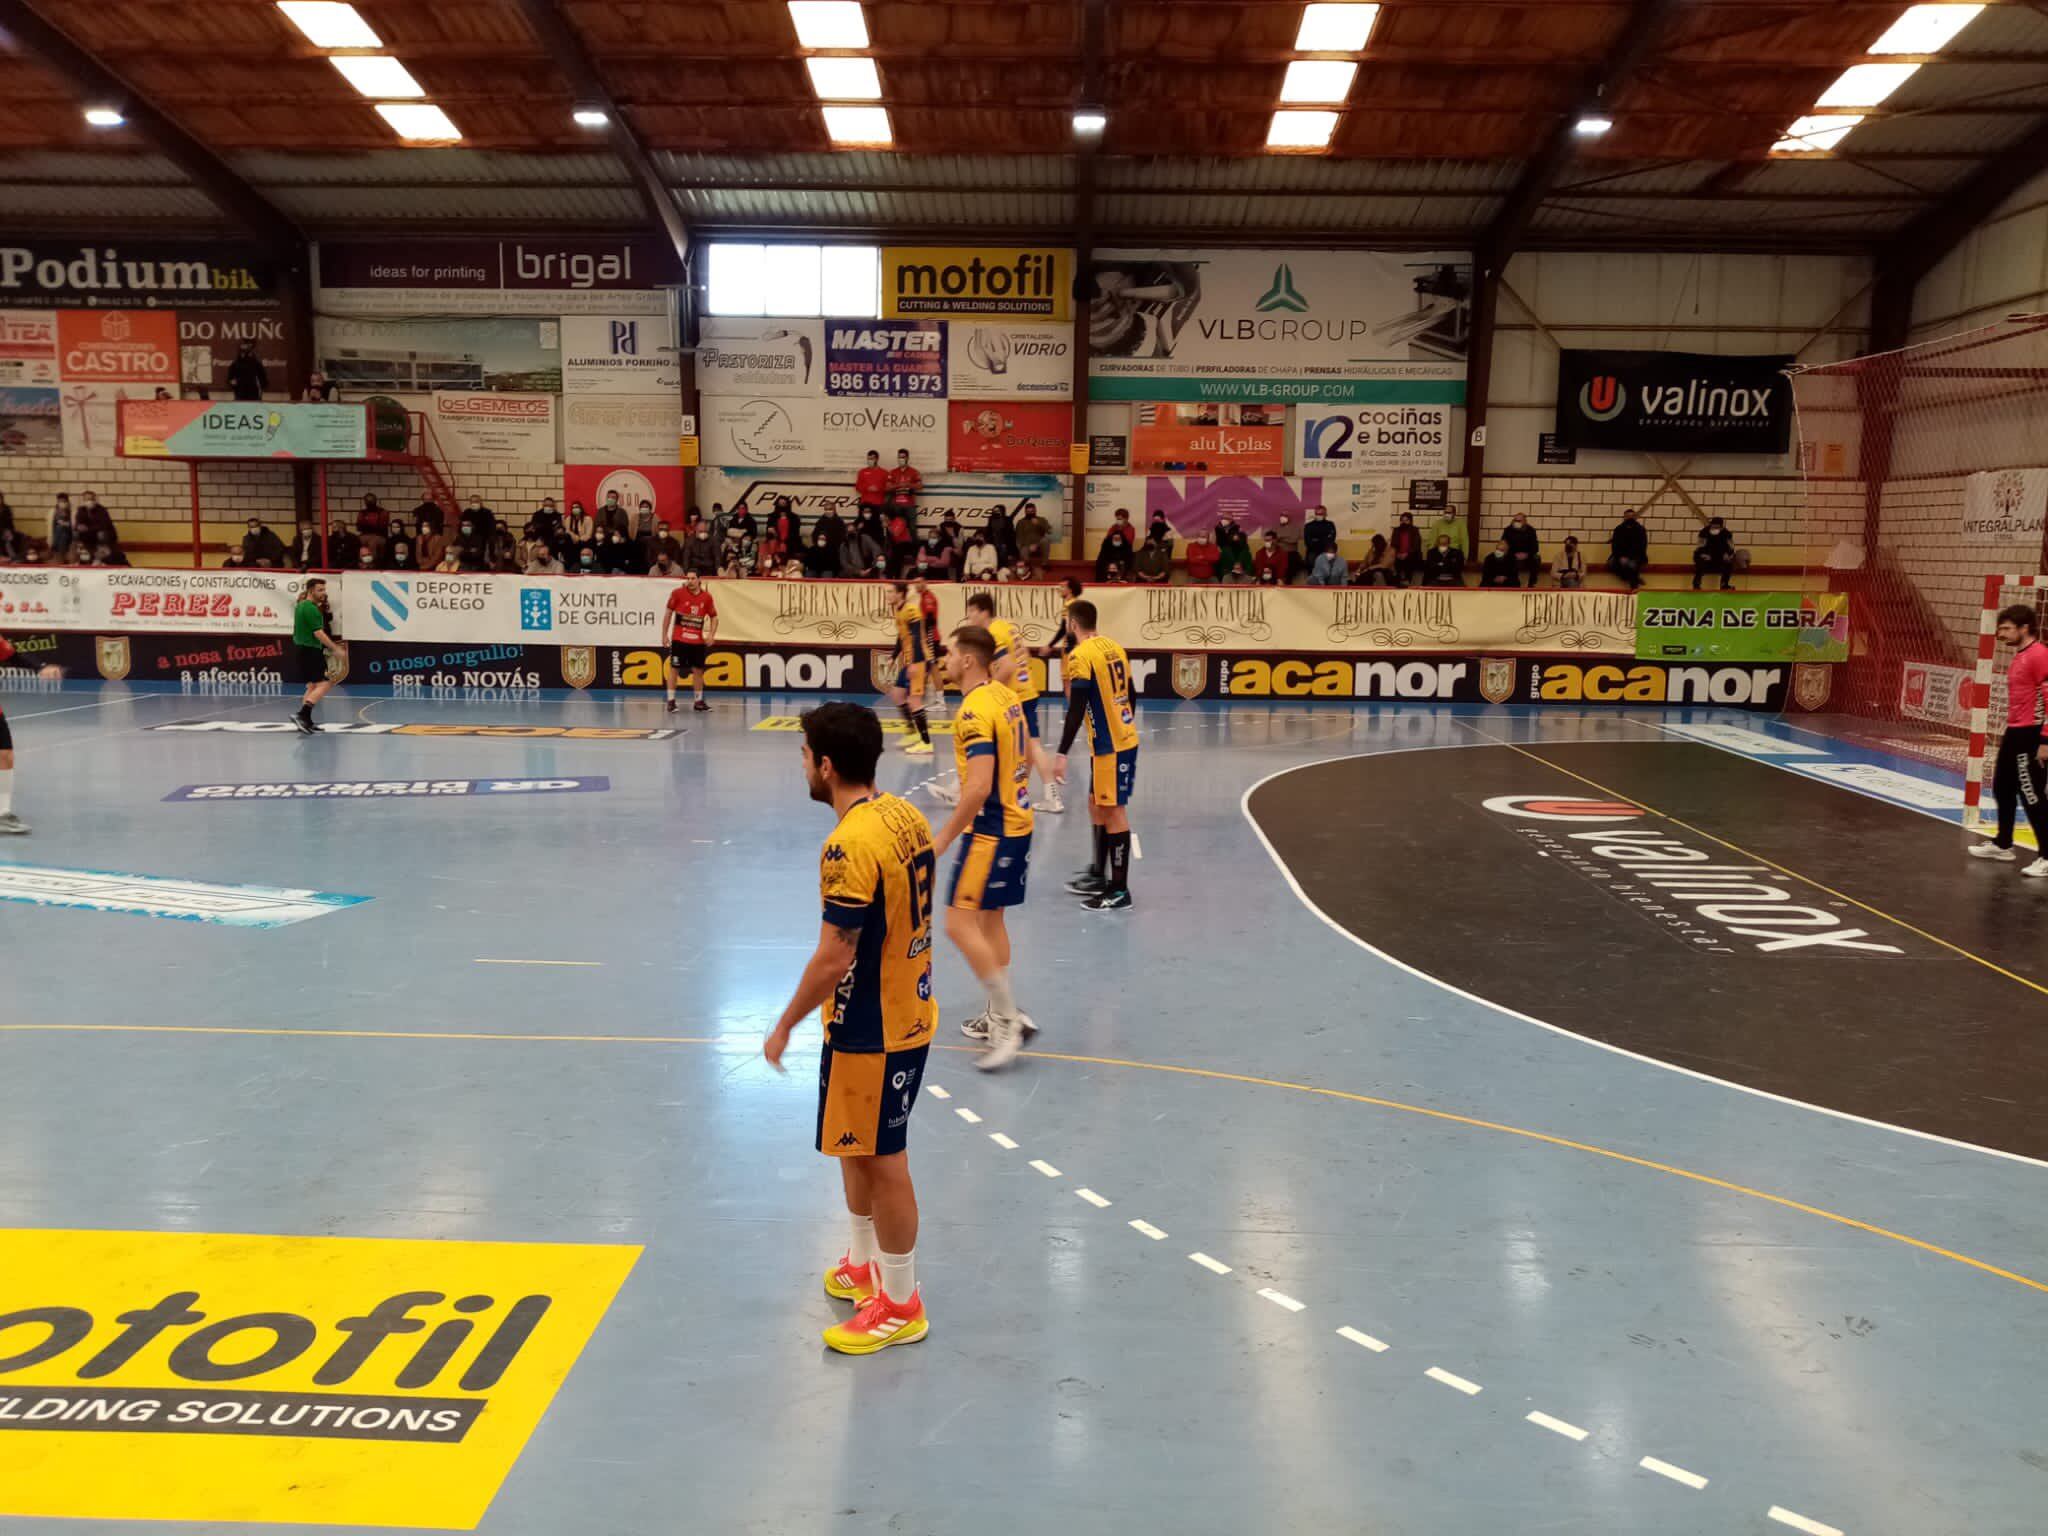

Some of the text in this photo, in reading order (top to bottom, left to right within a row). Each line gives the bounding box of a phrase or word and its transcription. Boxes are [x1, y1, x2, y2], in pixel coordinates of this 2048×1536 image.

[369, 264, 487, 281] ideas for printing
[515, 244, 632, 289] brigal
[897, 253, 1054, 296] motofil
[899, 300, 1052, 312] CUTTING & WELDING SOLUTIONS
[179, 320, 215, 340] DO
[831, 328, 941, 352] MASTER
[1197, 318, 1368, 342] VLBGROUP
[1013, 342, 1068, 357] VIDRIO
[65, 350, 170, 374] CASTRO
[567, 358, 623, 367] ALUMINIOS
[1099, 363, 1154, 373] CURVADORAS
[1195, 365, 1257, 374] PERFILADORAS
[1258, 366, 1269, 374] DE
[1270, 366, 1298, 375] CHAPA
[1303, 366, 1342, 375] PRENSAS
[830, 373, 864, 390] 986
[869, 374, 901, 391] 611
[908, 374, 942, 392] 973
[1199, 383, 1356, 398] WWW.VLB-GROUP.COM
[1641, 378, 1774, 417] valinox
[202, 413, 265, 431] IDEAS
[823, 407, 937, 431] FOTOVERANO
[1358, 408, 1443, 426] cociñas
[1357, 427, 1443, 445] e baños
[107, 574, 277, 591] EXCAVACIONES y CONSTRUCCIONES
[416, 581, 494, 596] DEPORTE
[416, 597, 486, 611] GALEGO
[559, 592, 618, 608] XUNTA
[777, 583, 895, 617] TERRAS GAUD
[1146, 589, 1266, 623] TERRAS GAUDA
[1332, 591, 1454, 625] TERRAS GAUDA
[1520, 593, 1638, 627] TERRAS GAUD
[558, 611, 656, 627] DE GALICIA
[1644, 608, 1836, 629] ZONA DE OBRA
[14, 633, 58, 654] xón!
[175, 650, 224, 667] nosa
[226, 640, 283, 661] forza!
[368, 644, 526, 674] o noso orgullo!
[612, 651, 623, 685] grupo
[181, 666, 282, 684] a afección
[391, 665, 541, 689] ser do NOVÁS
[1219, 659, 1467, 698] grupo acanor
[1530, 664, 1782, 705] grupo acanor
[1567, 829, 1905, 954] valinox
[0, 1290, 553, 1392] otofil
[0, 1397, 462, 1433] LDING SOLUTIONS
